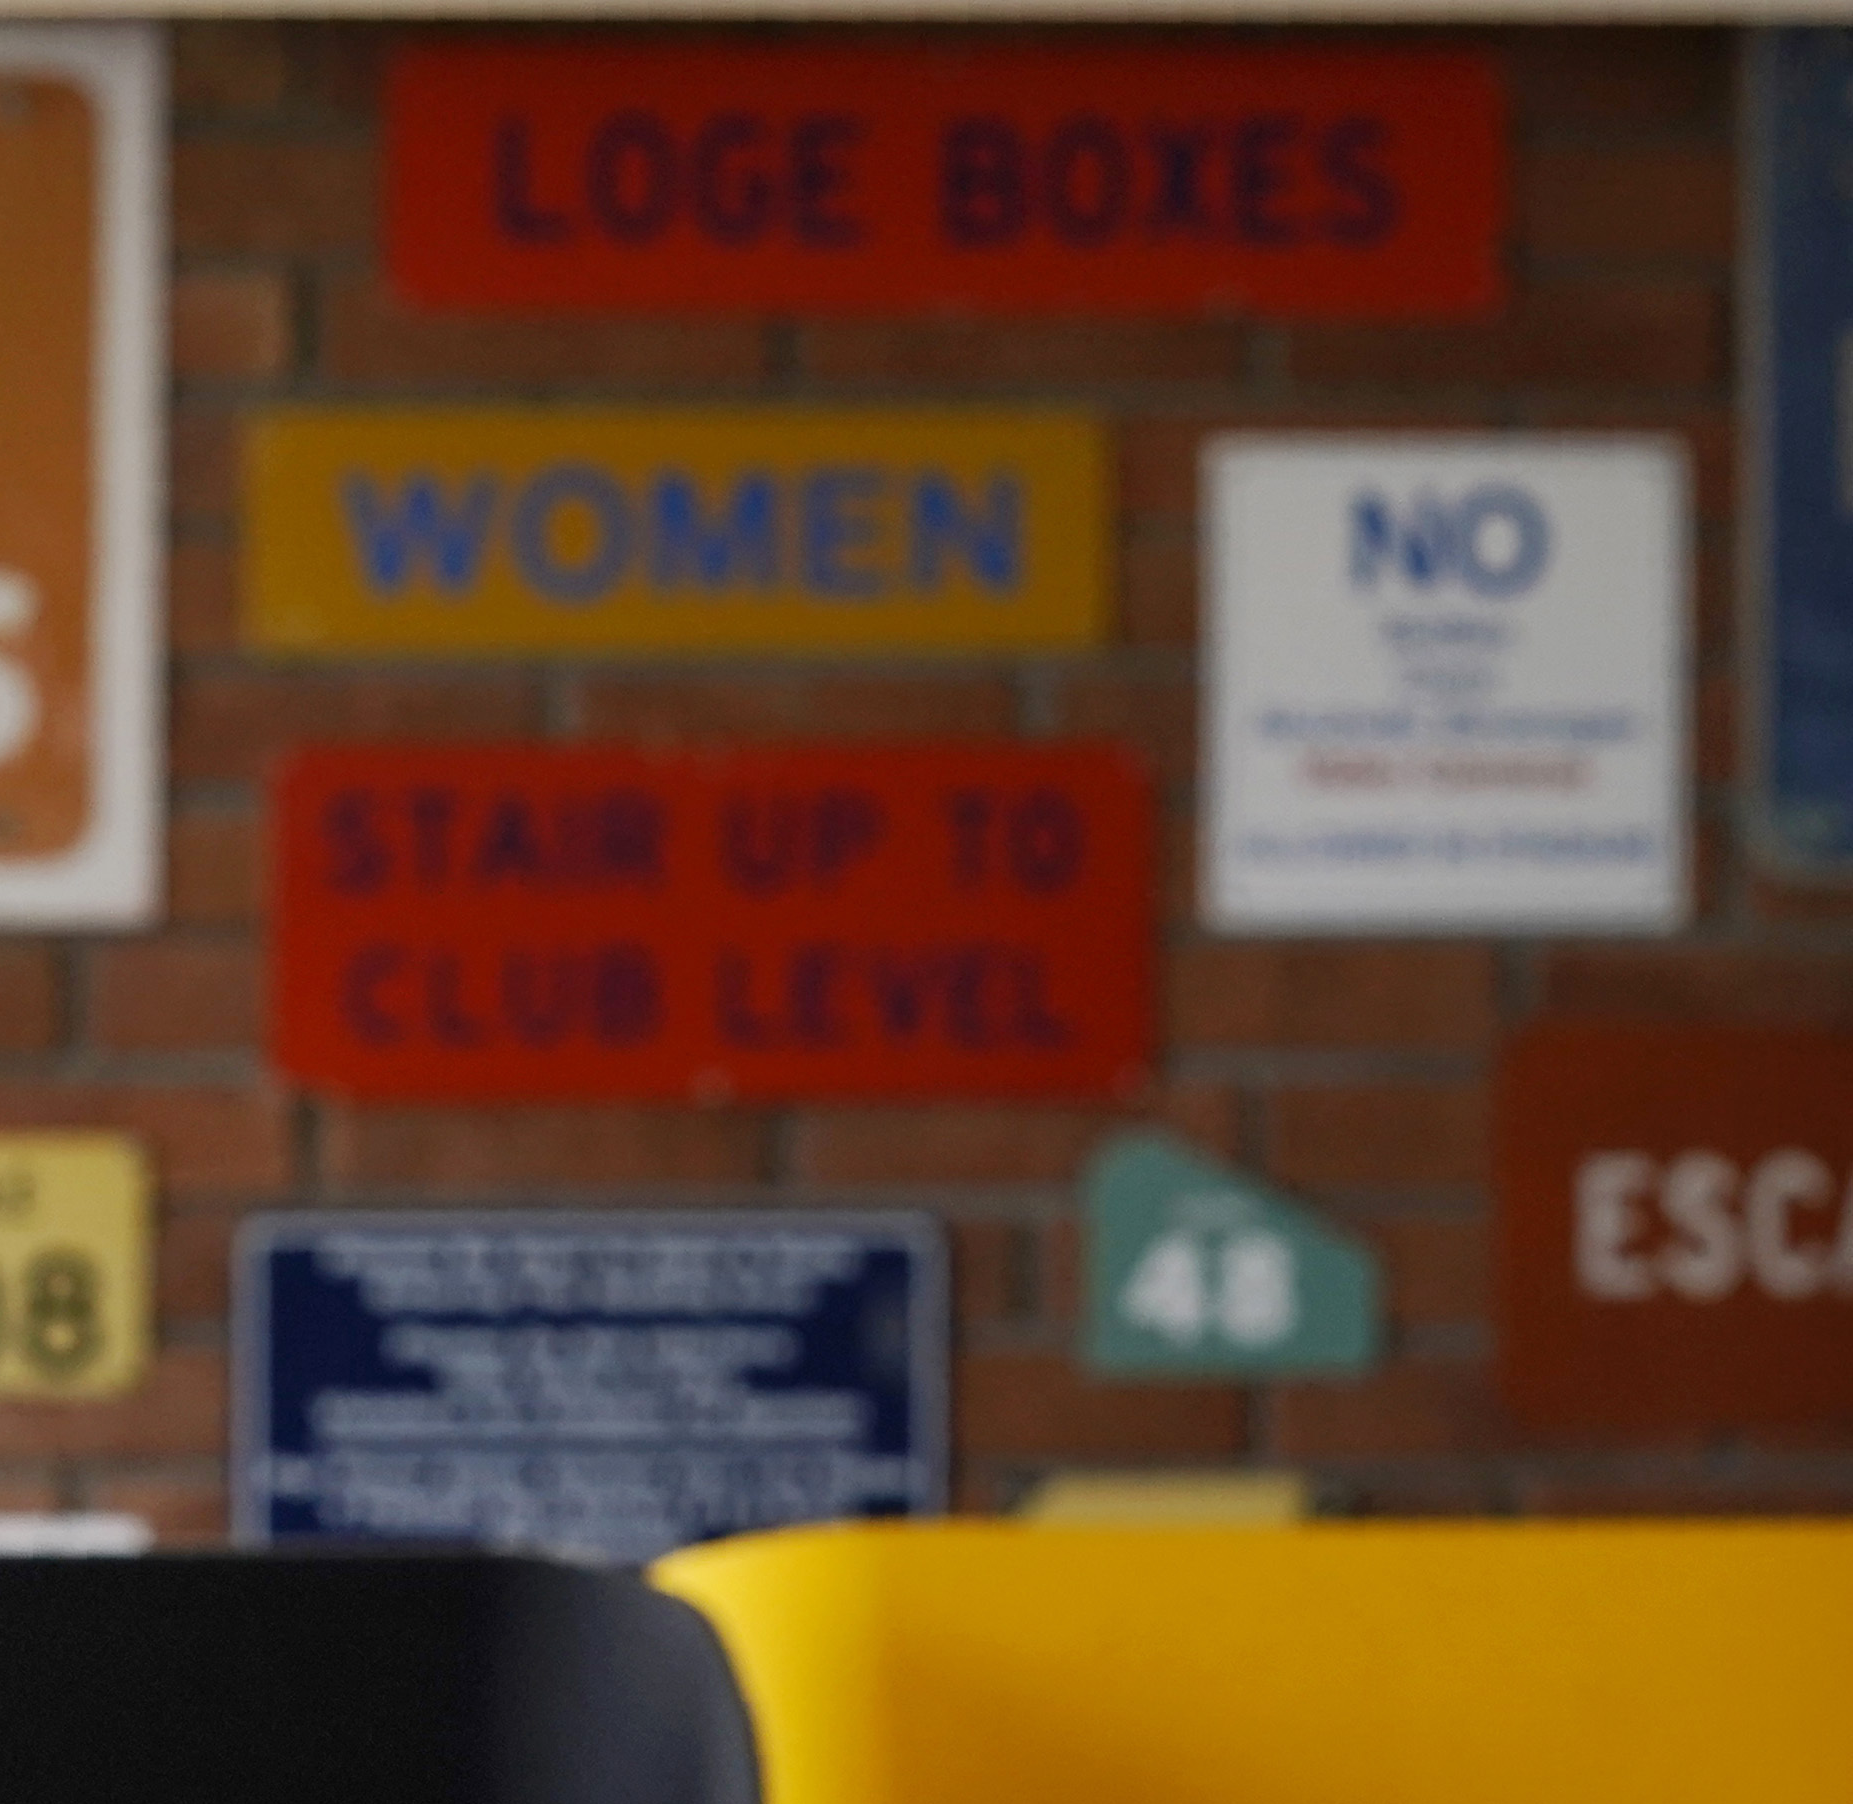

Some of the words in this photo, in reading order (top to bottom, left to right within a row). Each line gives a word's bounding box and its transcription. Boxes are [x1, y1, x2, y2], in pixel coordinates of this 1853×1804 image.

[493, 109, 866, 250] LOGE
[940, 109, 1402, 250] BOXES
[342, 465, 1028, 609] WOMEN
[1350, 483, 1554, 598] NO
[322, 789, 665, 899] STAIR
[722, 789, 883, 899] UP
[944, 789, 1086, 899] TO
[342, 940, 665, 1050] CLUB
[716, 940, 1079, 1050] LEVEL
